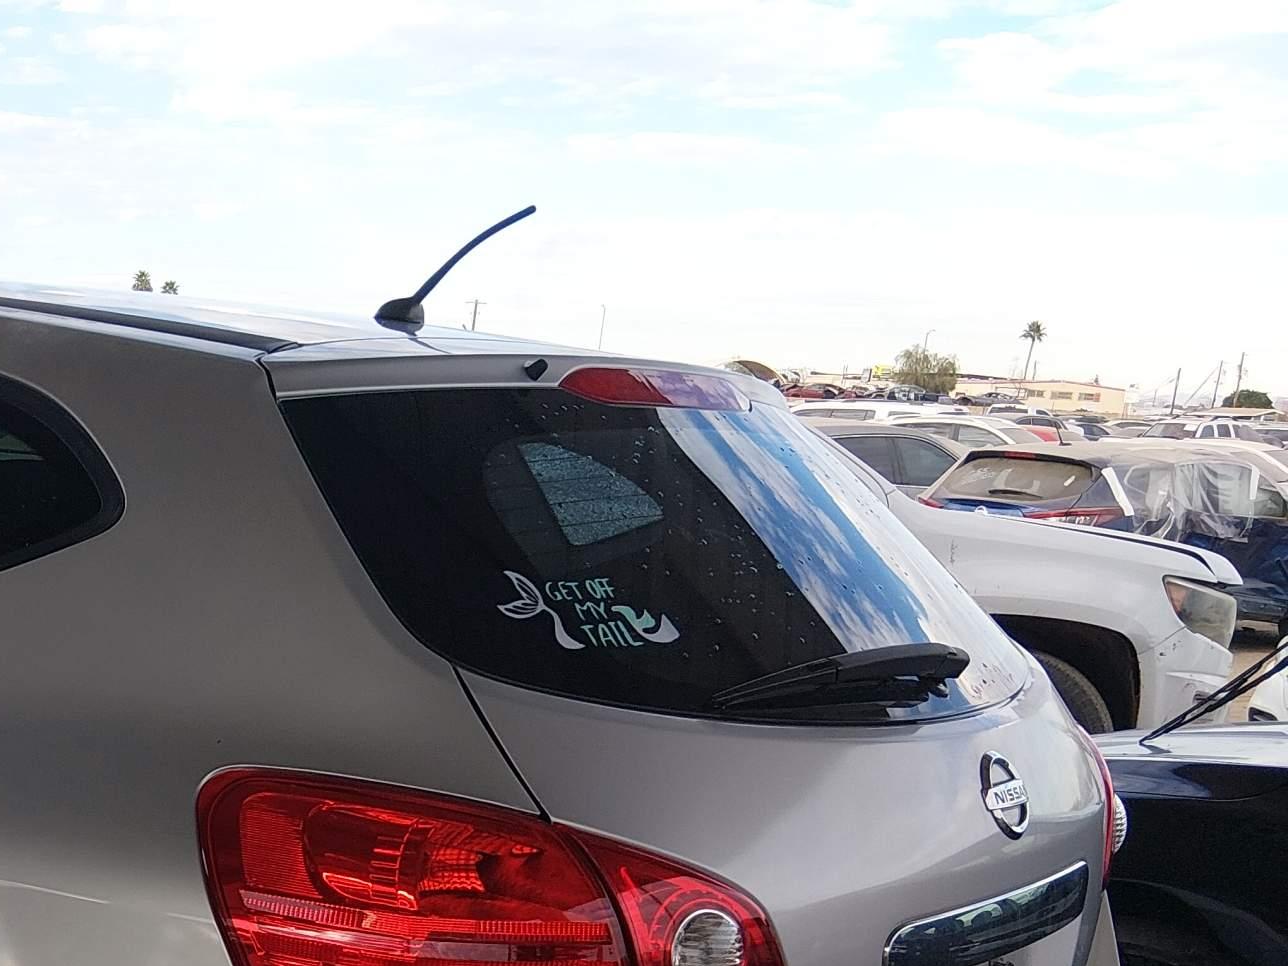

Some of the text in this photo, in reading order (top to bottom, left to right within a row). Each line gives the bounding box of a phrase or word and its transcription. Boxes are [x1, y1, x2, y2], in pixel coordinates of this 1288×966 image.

[545, 578, 615, 601] GET OFF
[574, 601, 608, 621] MY
[580, 620, 644, 648] TAIL
